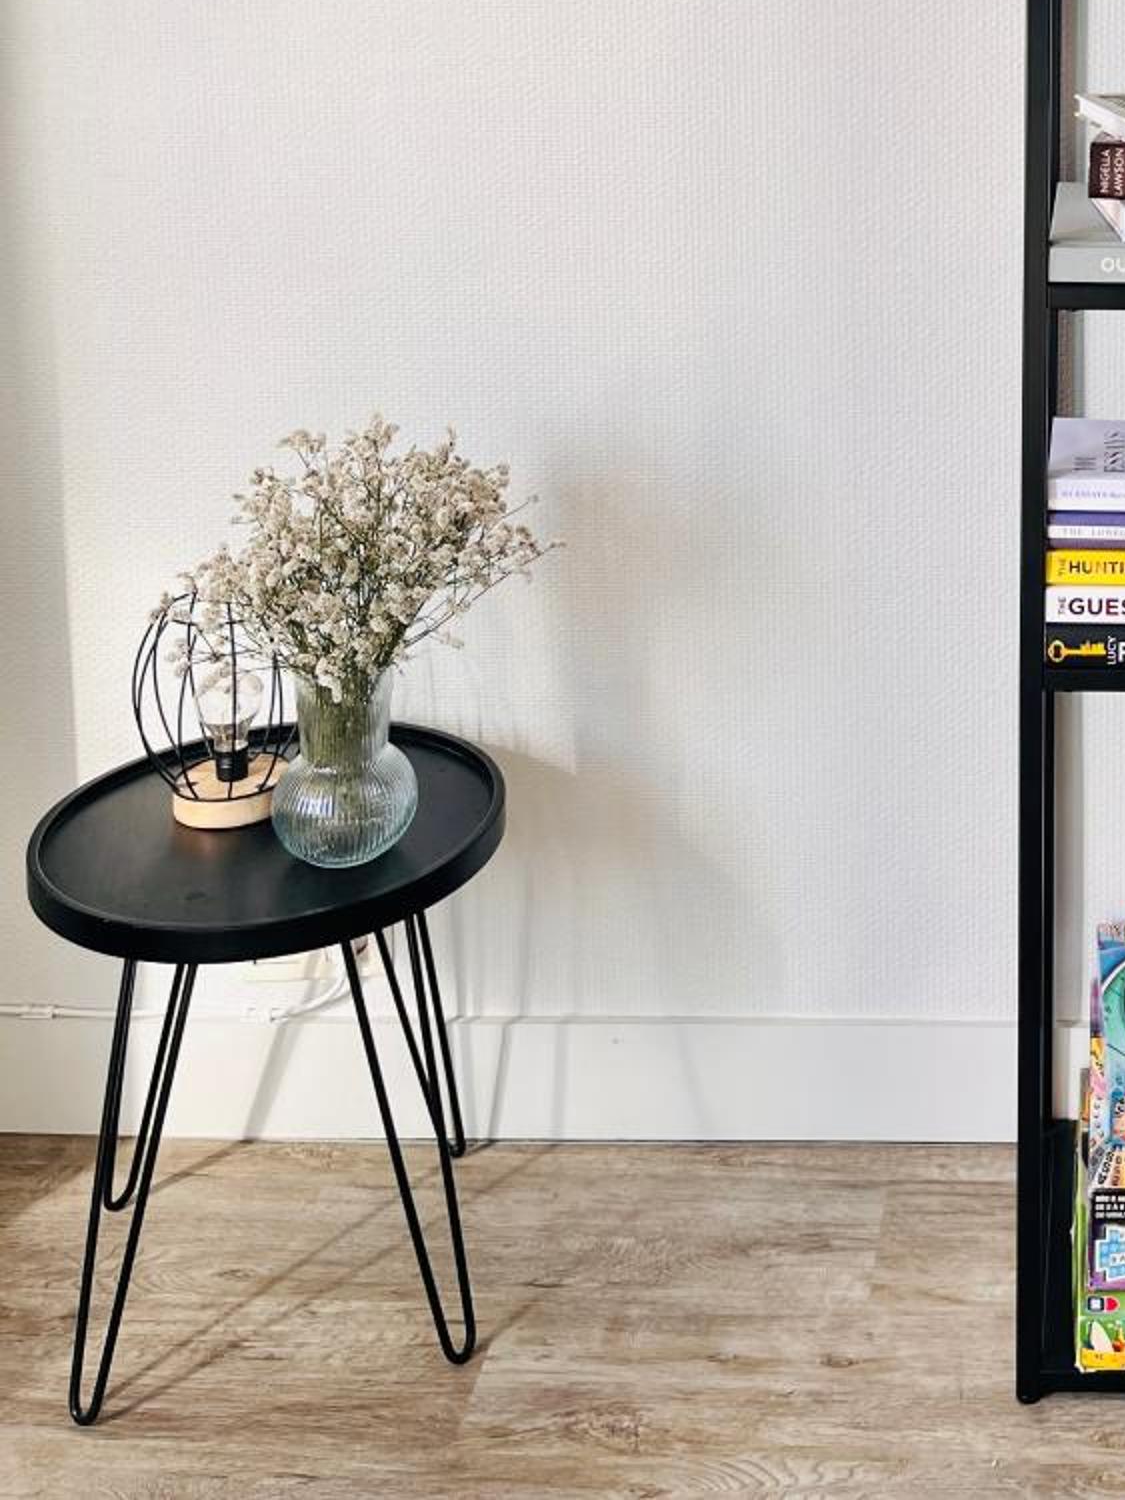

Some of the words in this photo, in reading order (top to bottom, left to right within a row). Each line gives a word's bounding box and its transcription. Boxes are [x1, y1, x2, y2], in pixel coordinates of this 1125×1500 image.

[1099, 149, 1111, 194] NIGELLA
[1113, 147, 1125, 197] LAWSON
[1107, 635, 1118, 665] LUCY
